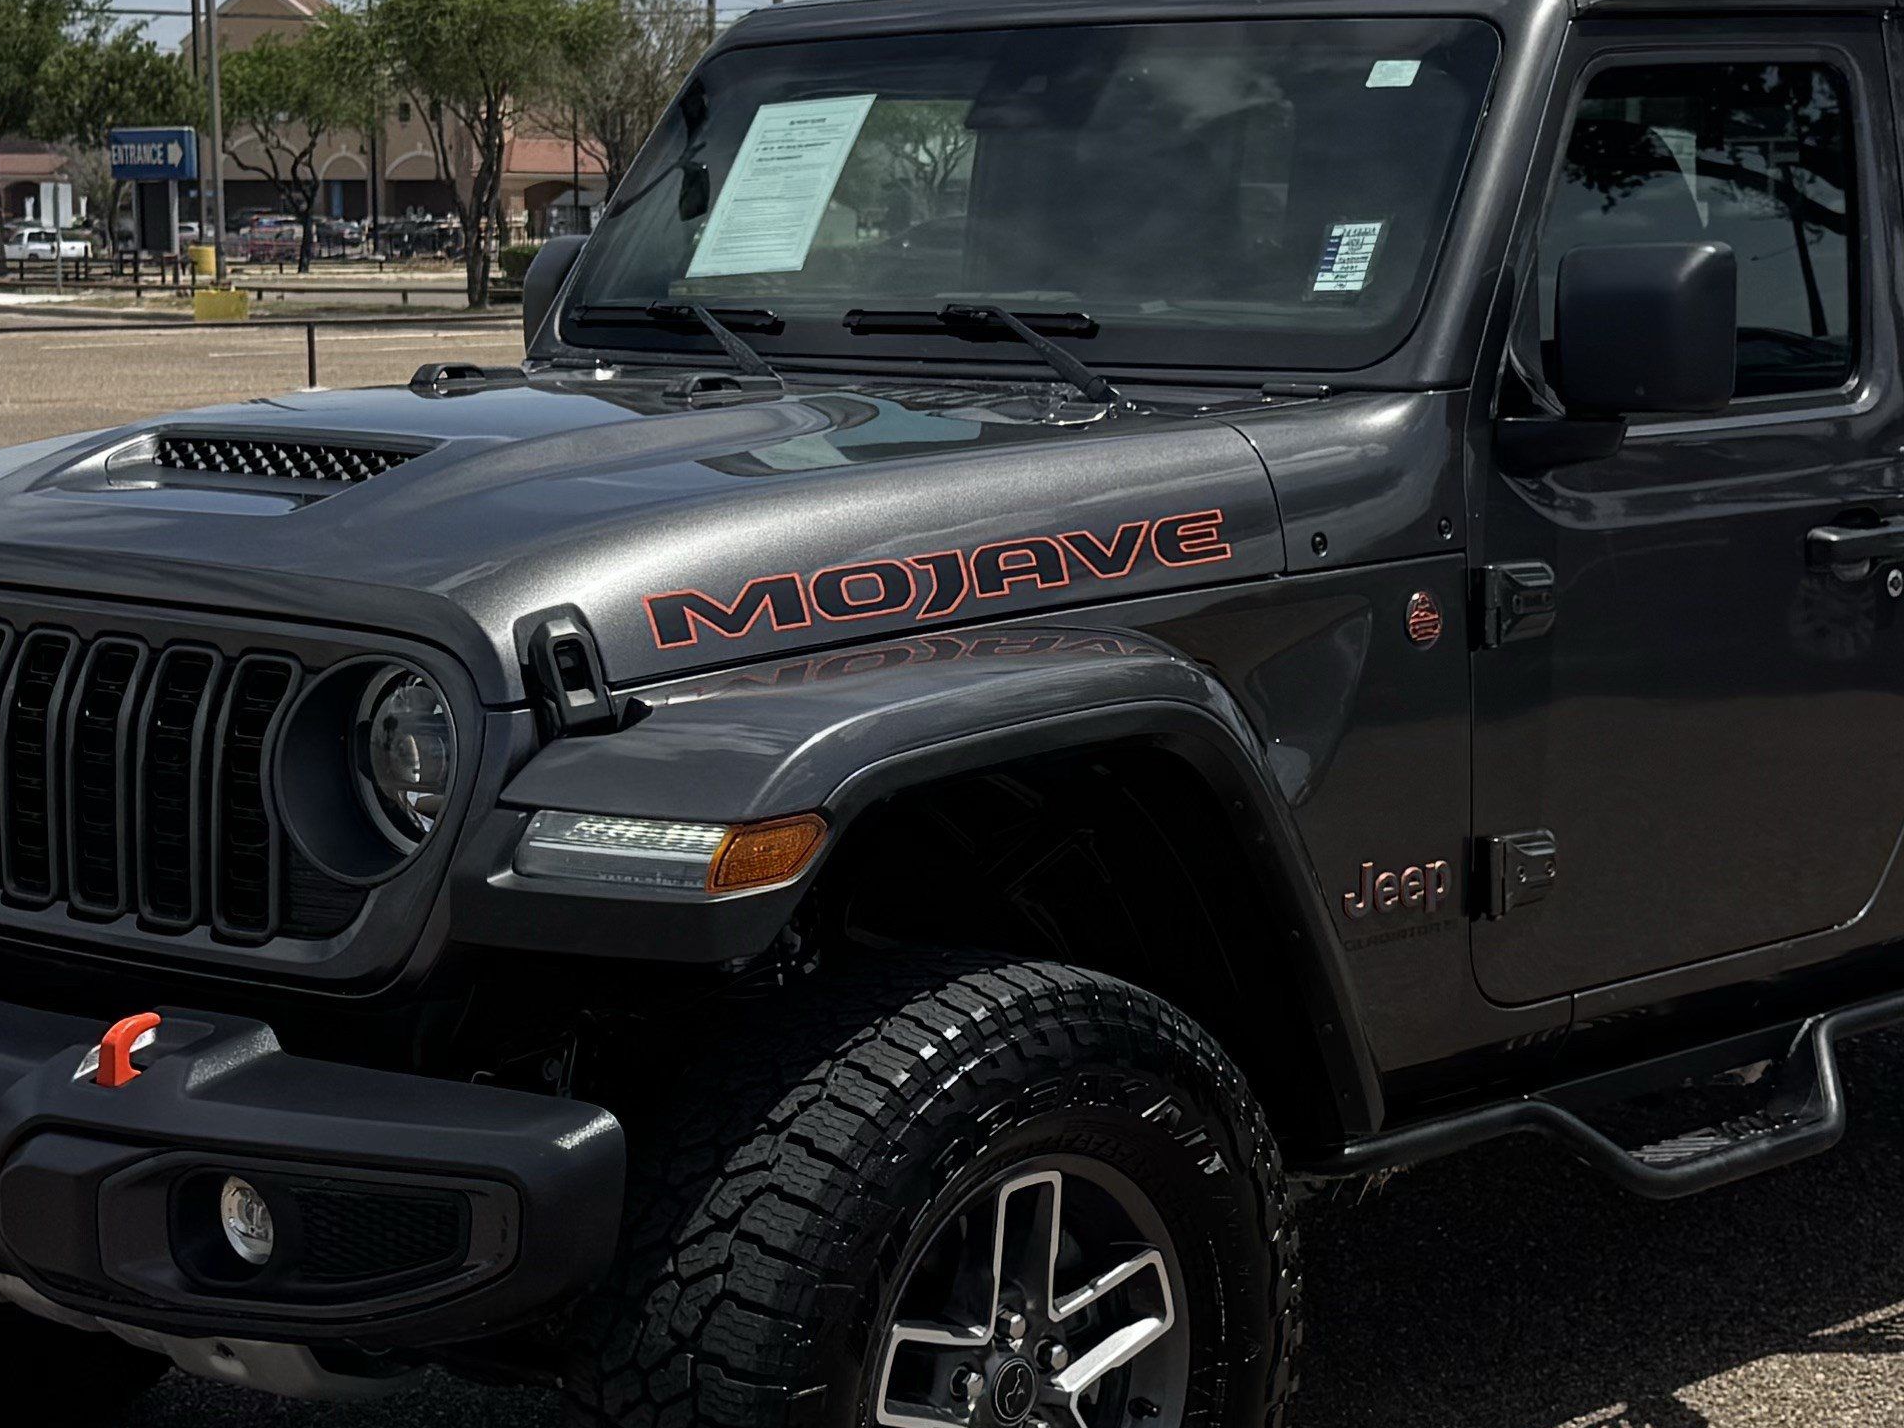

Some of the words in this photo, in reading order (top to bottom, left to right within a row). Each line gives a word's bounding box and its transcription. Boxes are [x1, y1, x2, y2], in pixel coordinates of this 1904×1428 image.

[111, 142, 164, 166] ENTRANCE
[641, 508, 1233, 650] MOJAVE
[1342, 859, 1453, 922] Jeep
